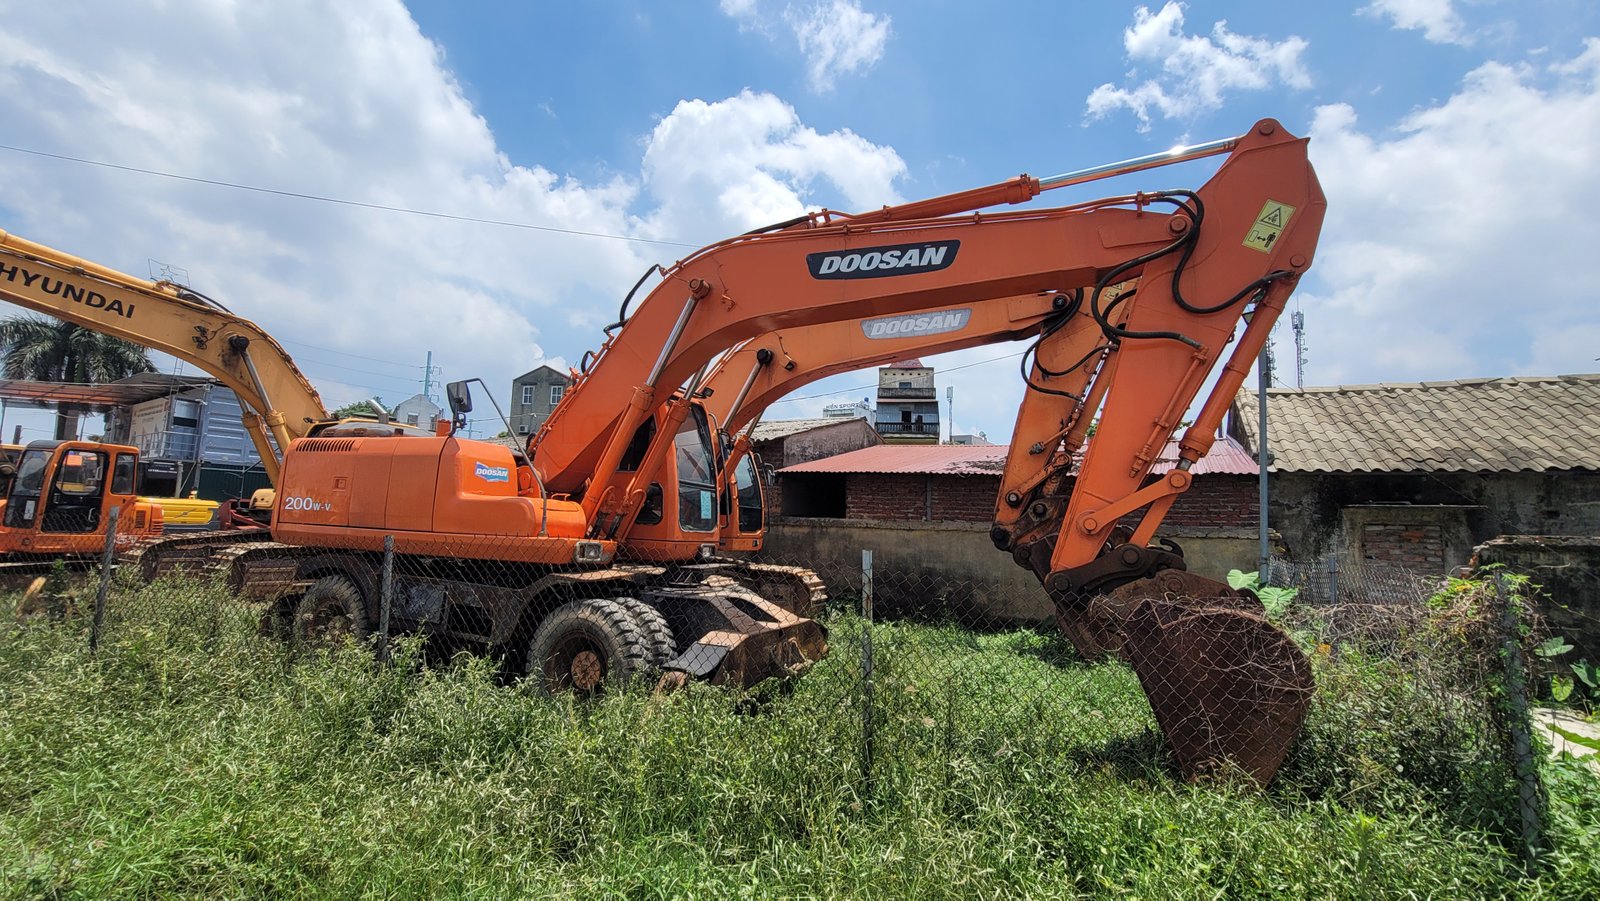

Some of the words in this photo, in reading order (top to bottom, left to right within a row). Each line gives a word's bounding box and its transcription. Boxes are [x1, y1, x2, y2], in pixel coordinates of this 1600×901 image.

[819, 245, 948, 275] DOOSAN
[0, 261, 136, 319] HYUNDAI
[870, 313, 962, 336] DOOSAN
[475, 467, 508, 477] DOOSAN
